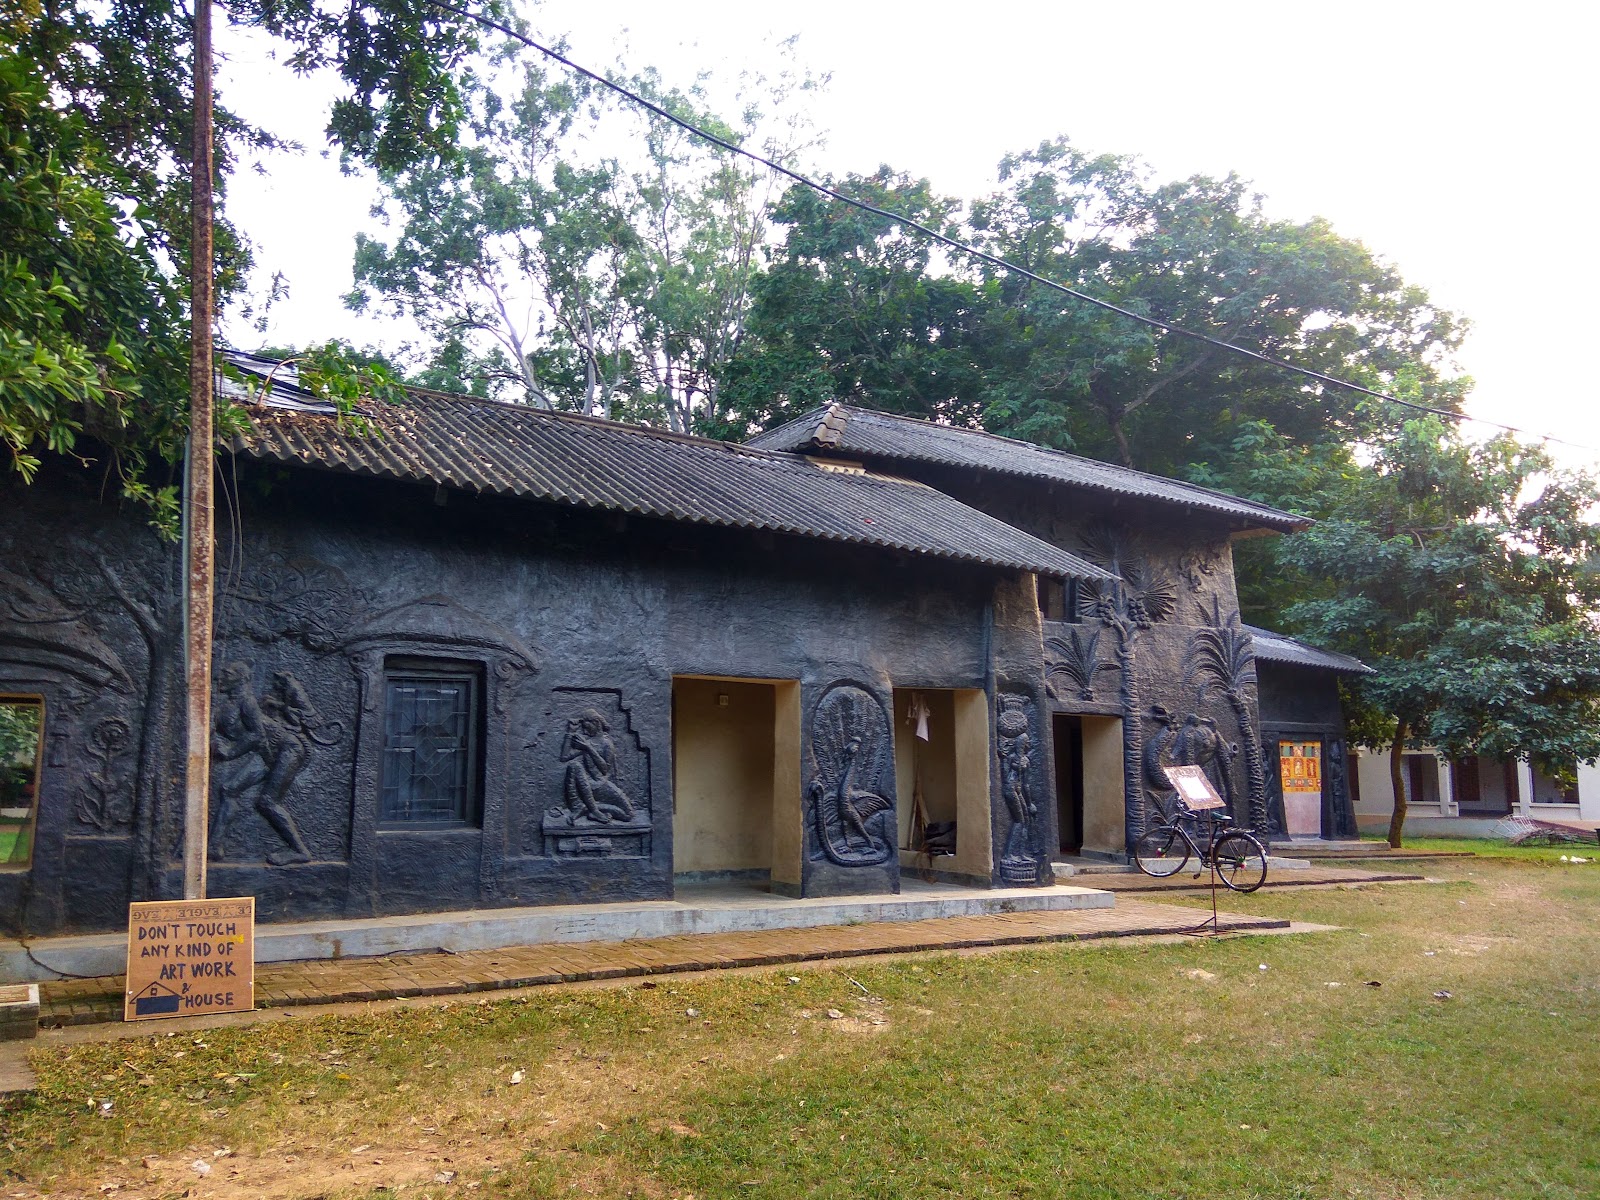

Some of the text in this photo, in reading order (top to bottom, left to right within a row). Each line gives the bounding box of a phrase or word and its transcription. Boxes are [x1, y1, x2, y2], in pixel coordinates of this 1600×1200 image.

[178, 907, 219, 918] EAGLE
[138, 922, 236, 939] DON'T TOUCH
[140, 942, 235, 958] ANY KIND OF
[159, 961, 236, 980] ART WORK
[182, 983, 192, 994] &
[184, 992, 234, 1008] HOUSE
